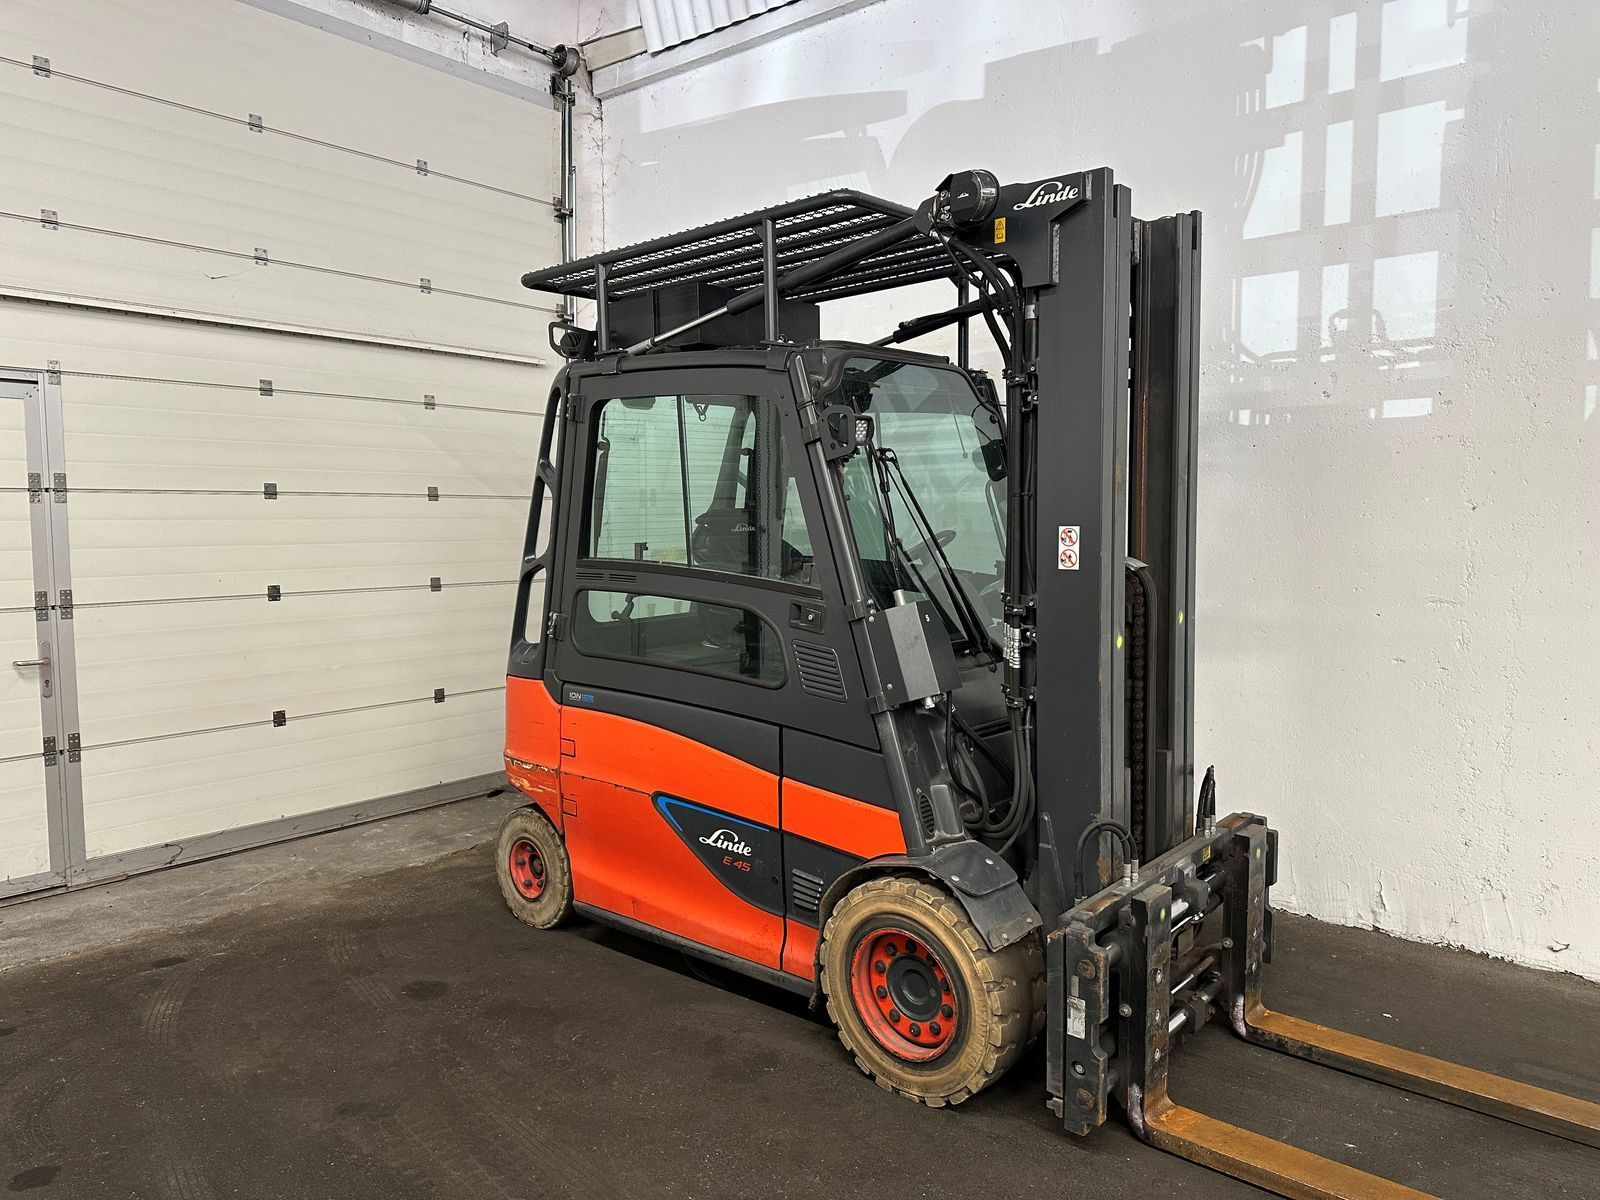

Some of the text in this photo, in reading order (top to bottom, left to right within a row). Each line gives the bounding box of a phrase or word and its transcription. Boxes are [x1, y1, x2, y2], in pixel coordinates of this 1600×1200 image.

[1013, 181, 1079, 211] Linde
[698, 829, 752, 856] Linde
[722, 855, 751, 872] E 45
